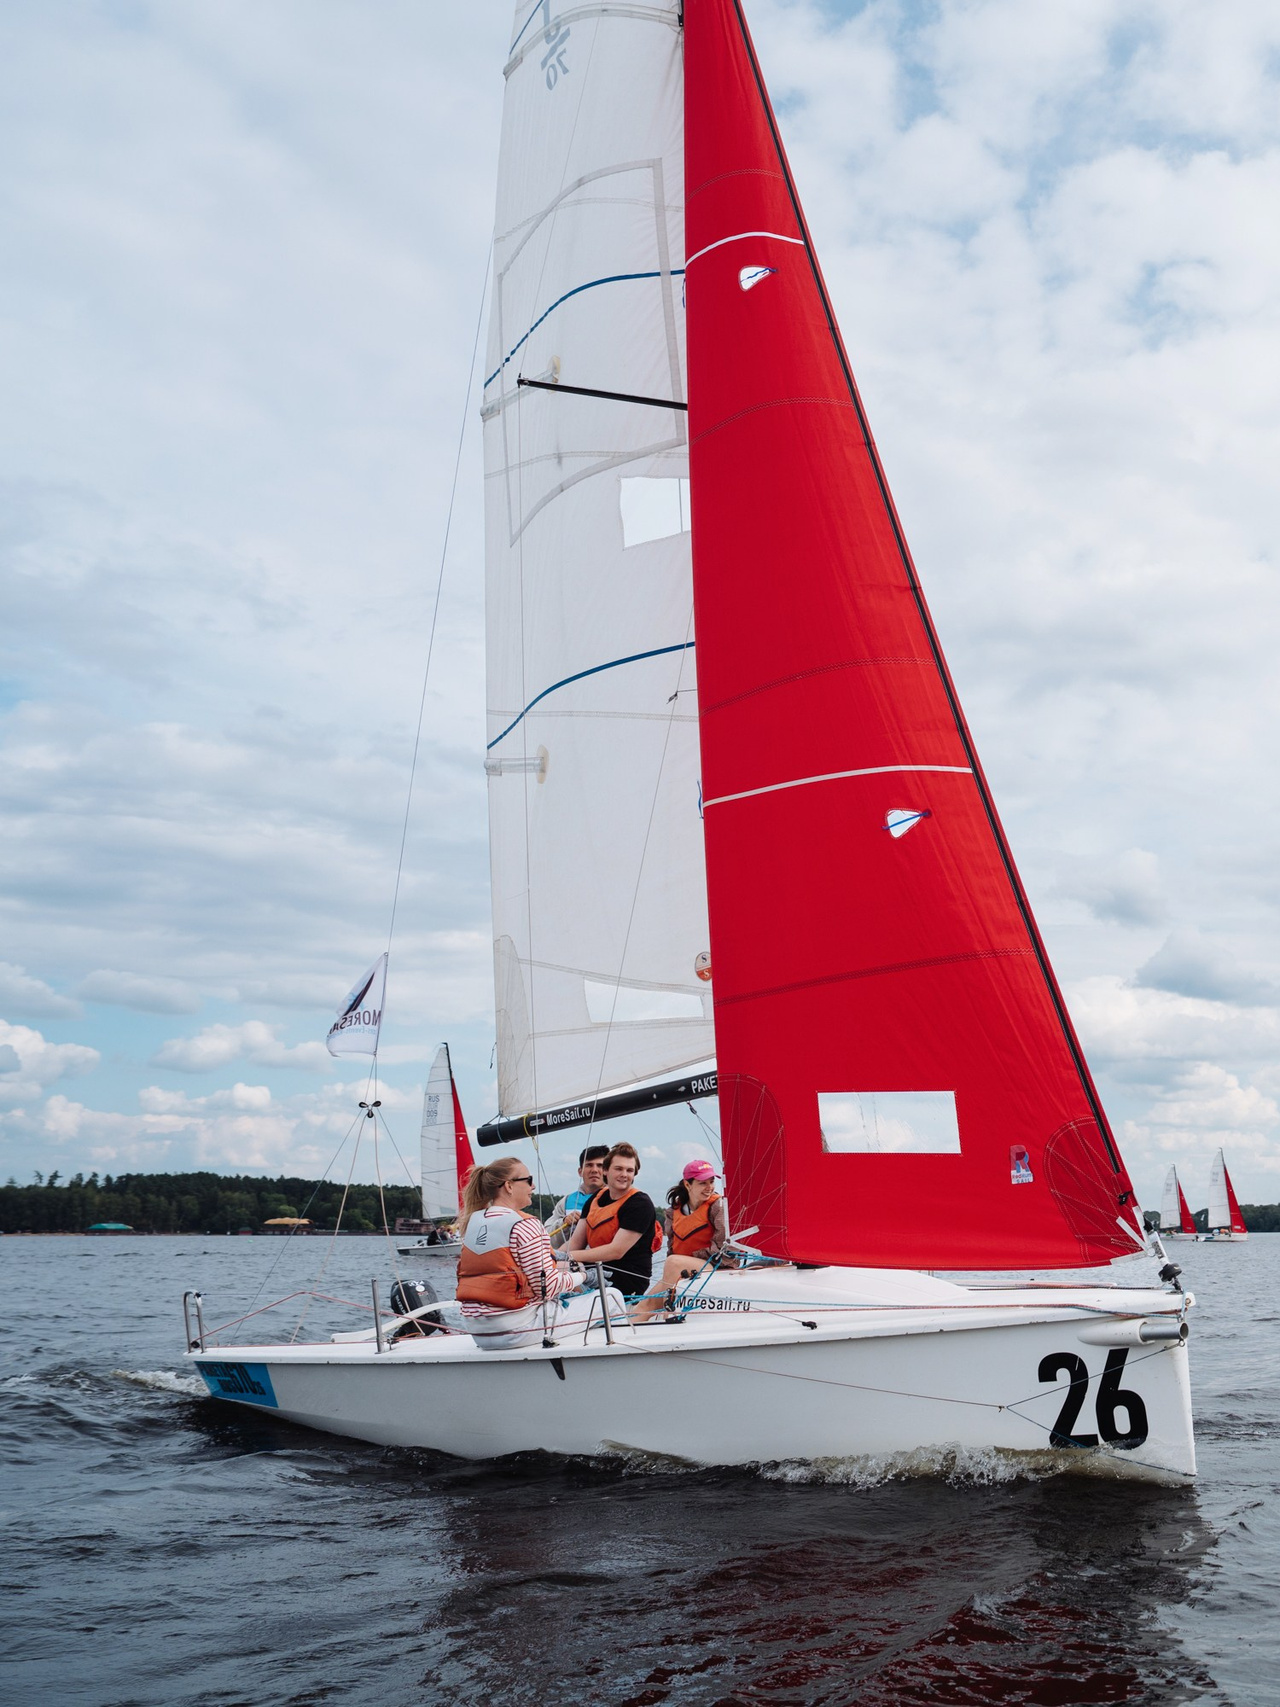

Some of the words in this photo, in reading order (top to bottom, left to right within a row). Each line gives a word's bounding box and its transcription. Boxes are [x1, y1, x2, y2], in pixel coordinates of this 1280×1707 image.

[691, 1075, 718, 1094] РАКЕ
[546, 1106, 592, 1126] MoreSail.ru
[676, 1295, 751, 1312] MoreSail.ru
[1038, 1348, 1149, 1450] 26
